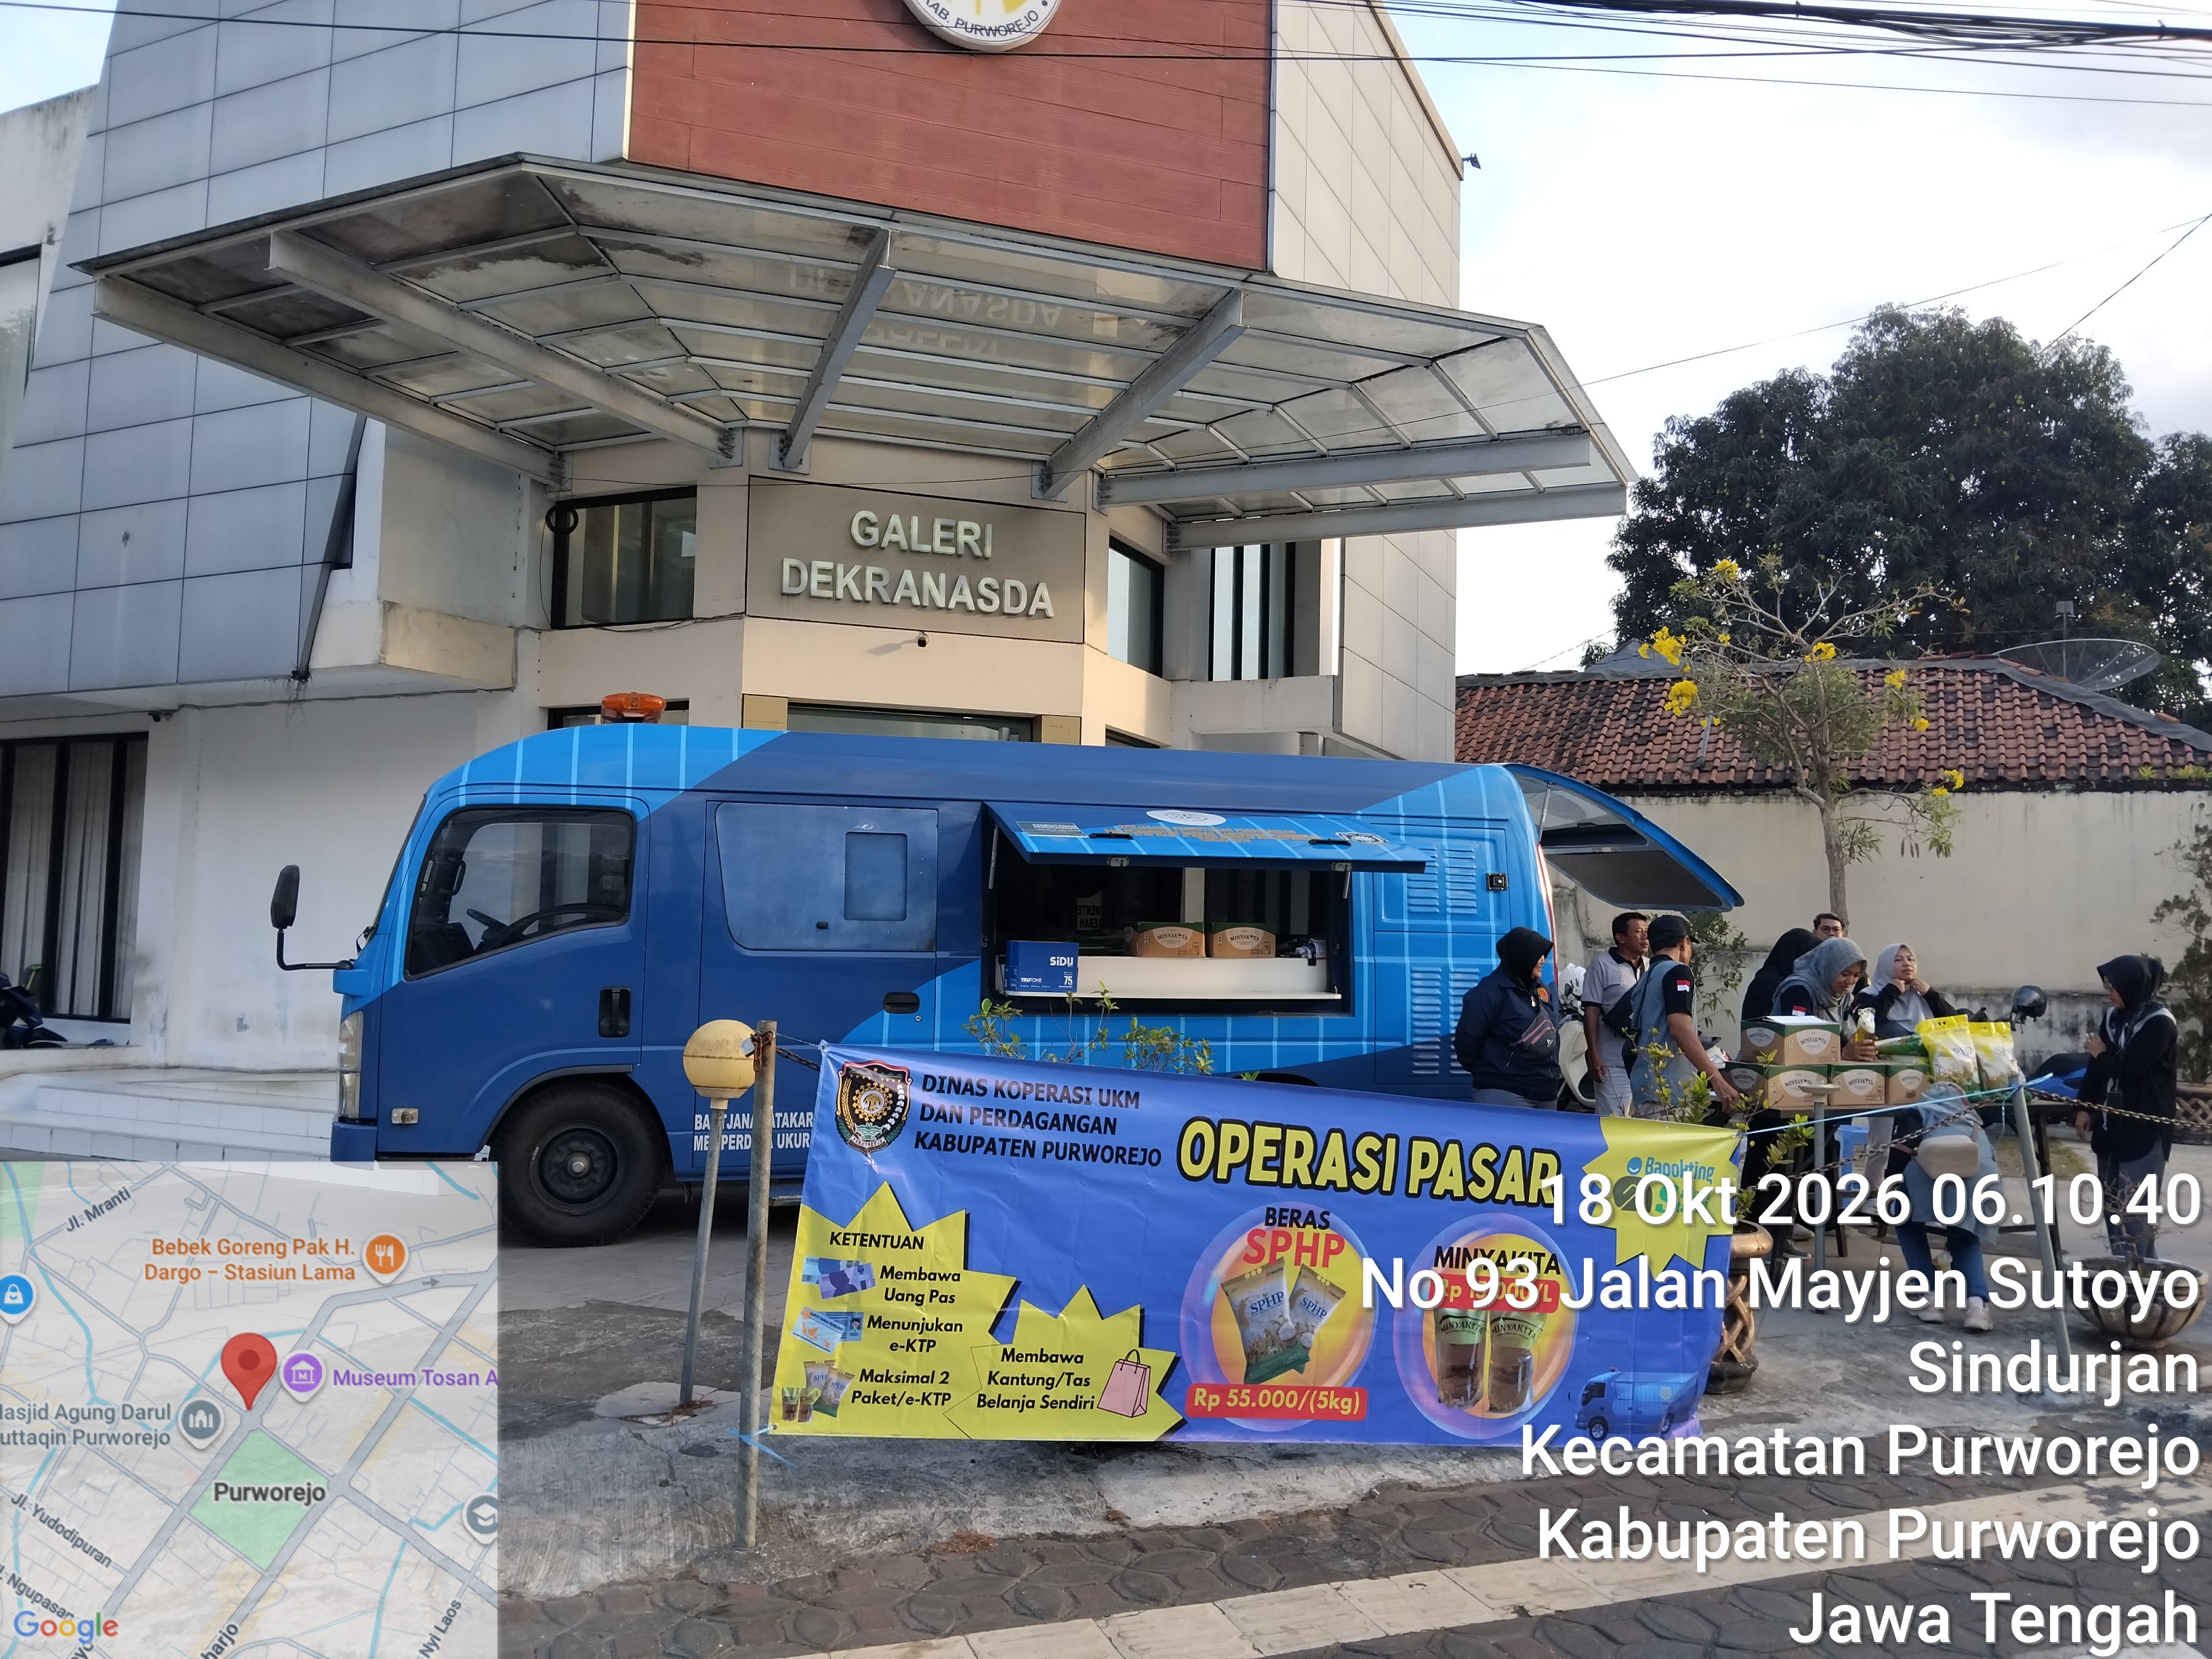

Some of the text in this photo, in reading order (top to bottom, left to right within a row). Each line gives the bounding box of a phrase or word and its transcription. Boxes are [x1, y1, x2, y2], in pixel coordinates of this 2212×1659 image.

[926, 0, 1039, 37] AB. PURWOREJO
[851, 510, 992, 559] GALERI
[781, 557, 1054, 618] DEKRANASDA
[1064, 975, 1073, 985] 75
[922, 1073, 1140, 1109] DINAS KOPERASI UKM
[919, 1103, 1117, 1136] DAN PERDAGANGAN
[914, 1132, 1036, 1160] KABUPATEN
[1042, 1140, 1162, 1168] PURWOREJO
[1177, 1115, 1561, 1207] OPERASI PASAR
[1265, 1207, 1330, 1229] BERAS
[830, 1231, 924, 1250] KETENTUAN
[1242, 1228, 1345, 1268] SPHP
[1433, 1246, 1561, 1275] MINYAKITA
[880, 1265, 961, 1282] Membawa
[884, 1288, 956, 1306] Uang Pas
[1250, 1291, 1284, 1315] SPHP
[1300, 1296, 1328, 1318] SPHP
[867, 1315, 963, 1335] Menunjukan
[889, 1339, 937, 1353] e-KTP
[1001, 1348, 1084, 1364] Membawa
[859, 1368, 950, 1385] Maksimal 2
[987, 1371, 1090, 1390] Kantung/Tas
[851, 1389, 951, 1407] Paket/e-KTP
[977, 1393, 1095, 1413] Belanja Sendiri
[1193, 1387, 1360, 1415] Rp 55.000/(5kg)
